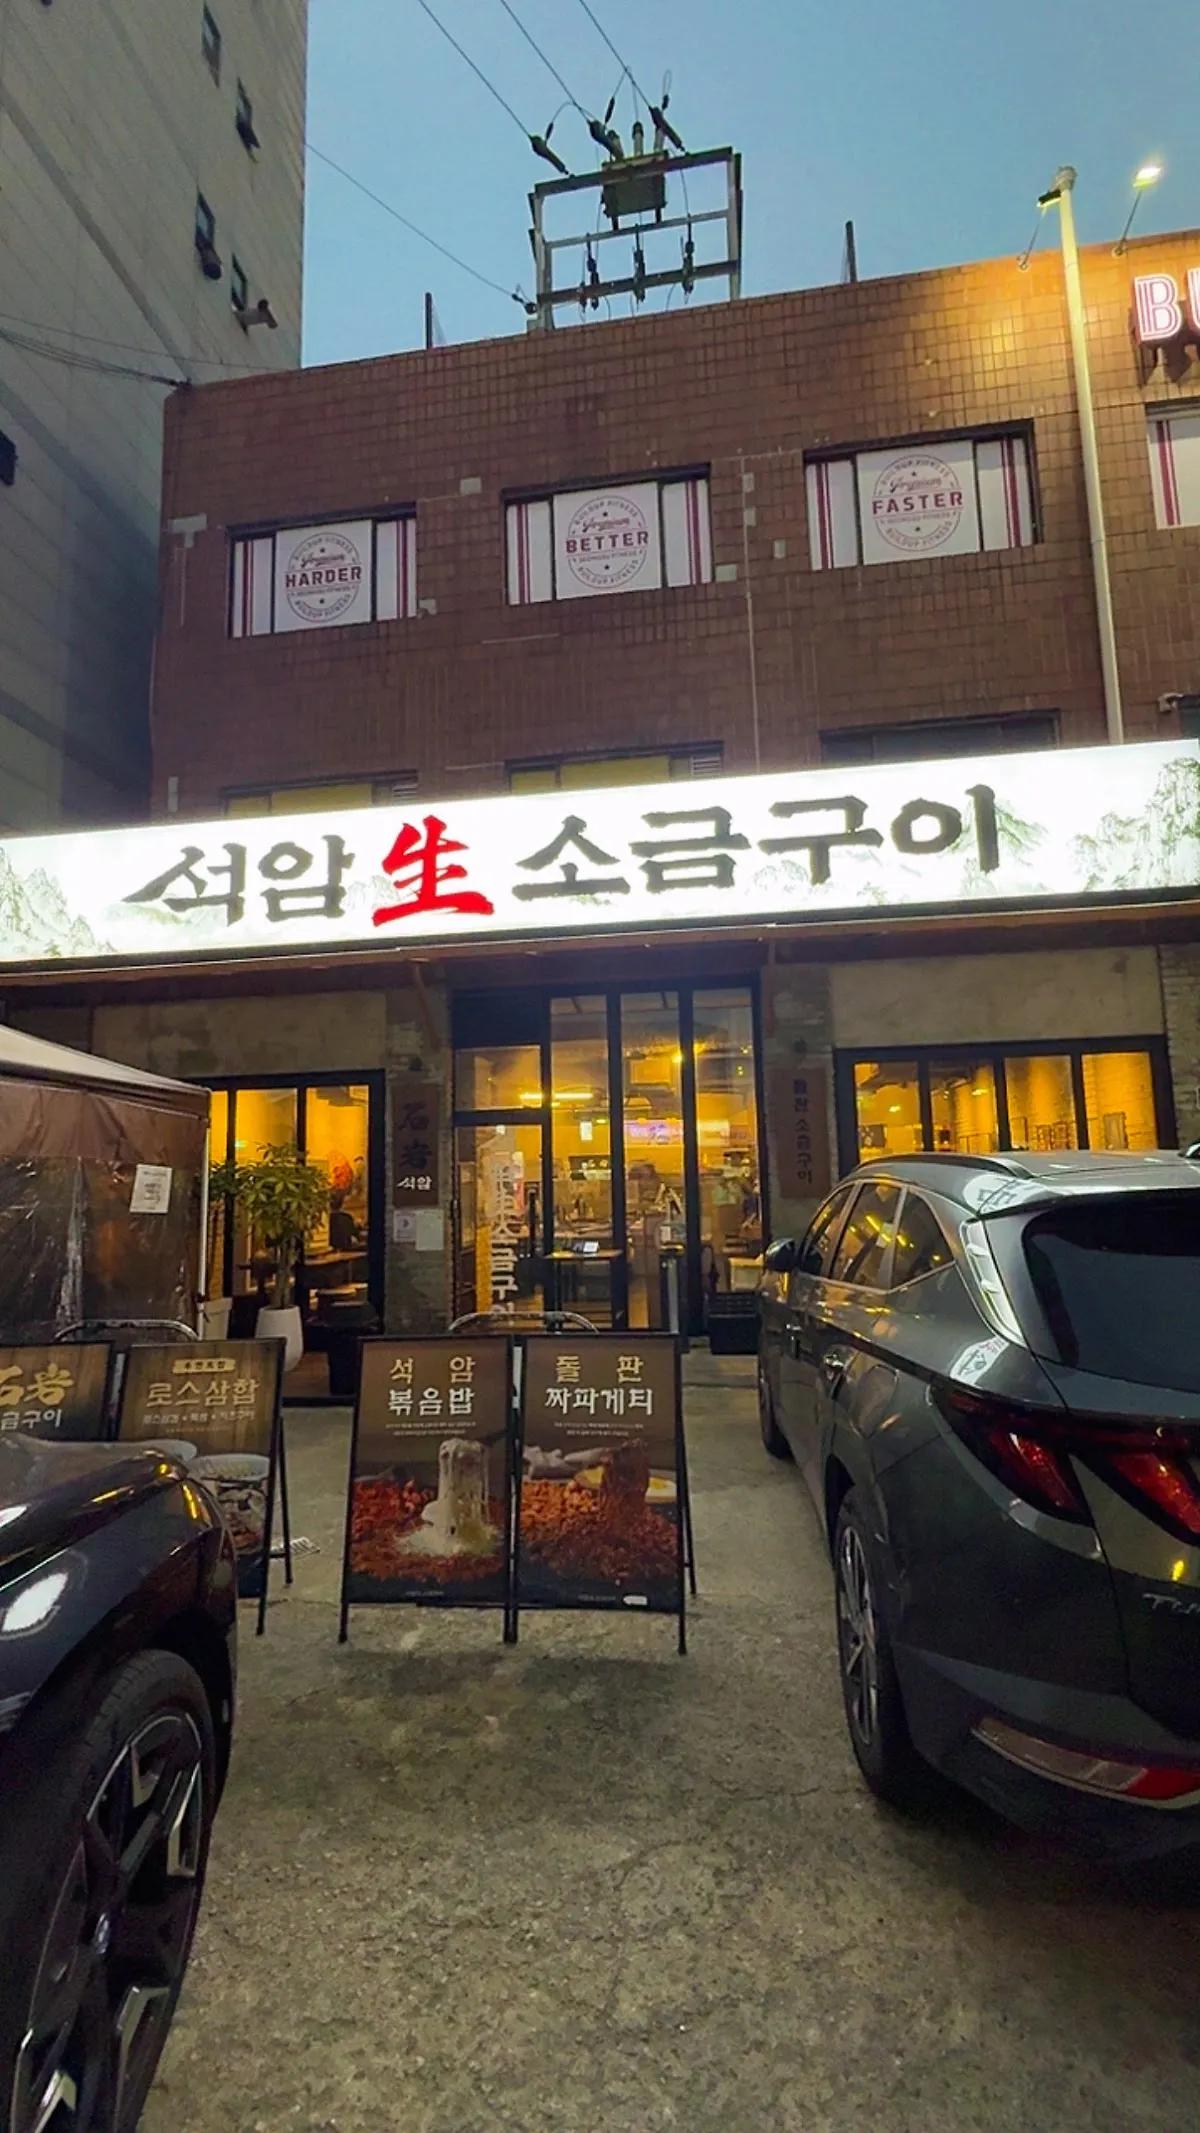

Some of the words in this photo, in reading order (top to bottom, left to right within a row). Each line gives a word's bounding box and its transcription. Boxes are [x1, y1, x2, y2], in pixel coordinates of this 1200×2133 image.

[872, 491, 963, 515] FASTER
[566, 530, 649, 554] BETTER
[286, 566, 362, 588] HARDER
[511, 784, 1000, 901] 소금구이
[397, 1175, 433, 1191] 석암
[146, 1378, 261, 1408] 로스삼합
[388, 1386, 476, 1416] 볶음밥
[544, 1386, 653, 1416] 짜파게티
